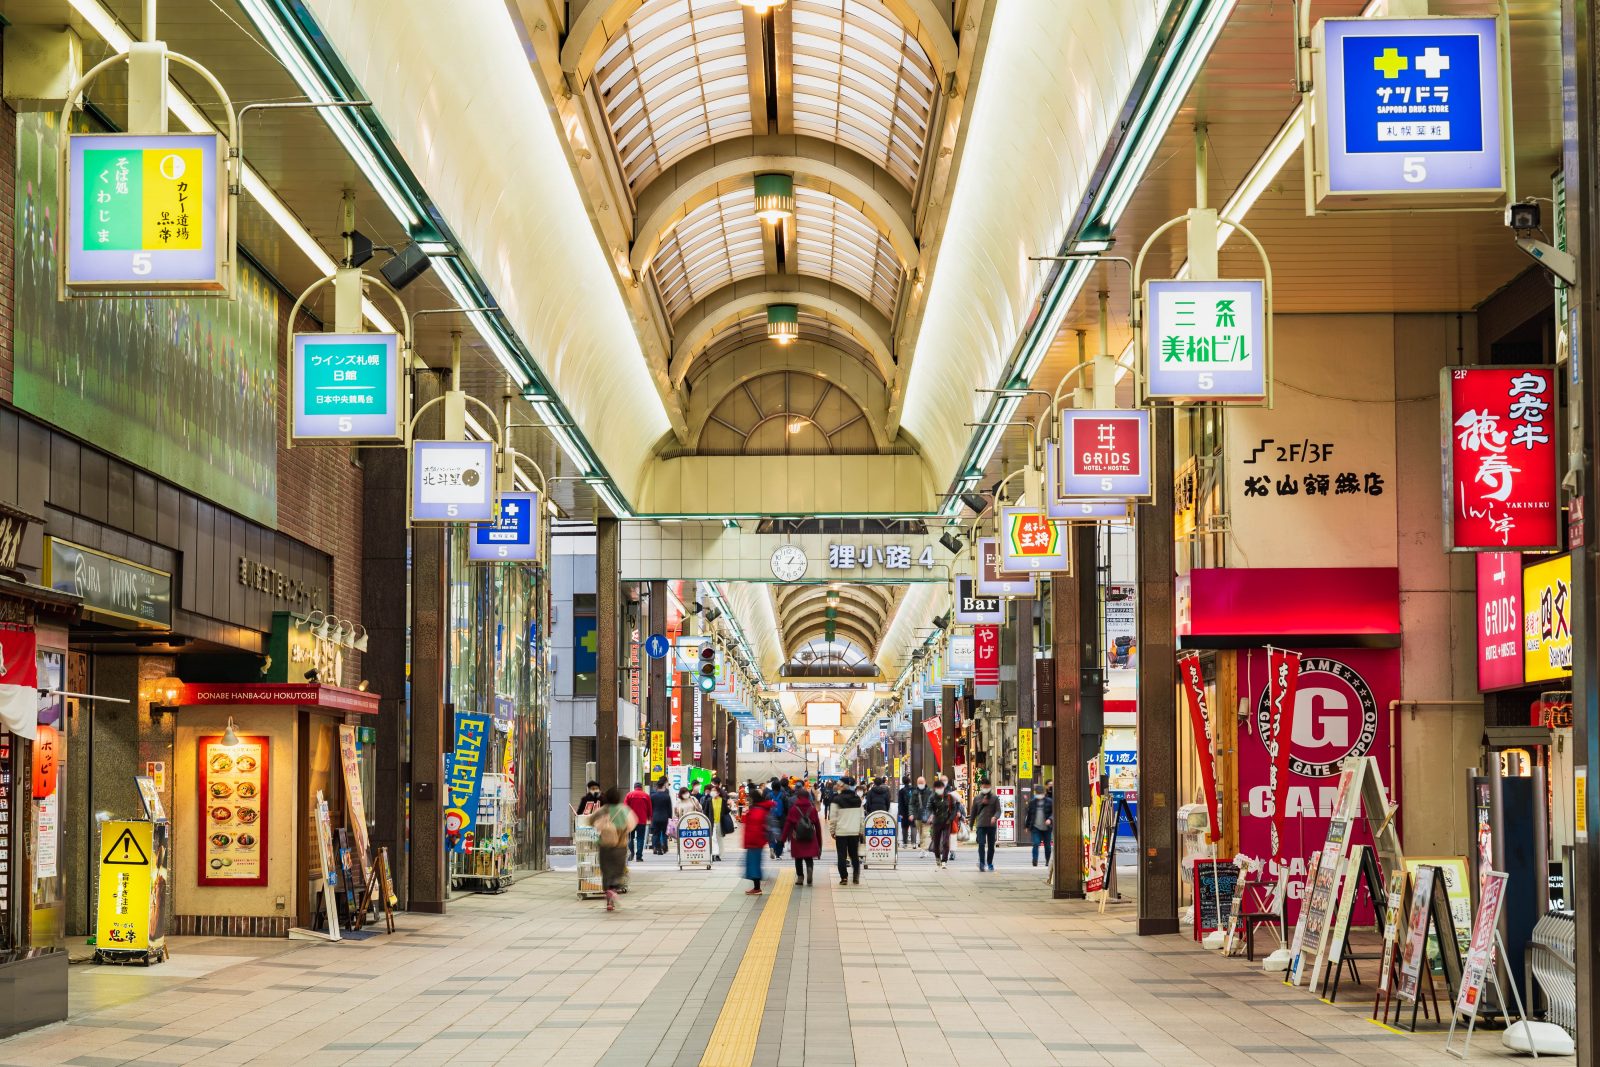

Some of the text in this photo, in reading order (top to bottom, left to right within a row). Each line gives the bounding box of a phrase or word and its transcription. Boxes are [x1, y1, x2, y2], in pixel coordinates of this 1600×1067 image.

[1376, 87, 1450, 104] サツドラ
[1377, 105, 1449, 115] SAPPORO DRUG STORE
[115, 157, 129, 195] そば処
[1403, 156, 1427, 183] 5
[97, 169, 112, 243] くわじま
[176, 181, 190, 241] カレー道場
[132, 252, 152, 275] 5
[1162, 335, 1250, 363] 美松ビル
[311, 354, 380, 366] ウインズ札幌
[1198, 372, 1214, 390] 5
[1454, 369, 1468, 380] 2F
[316, 395, 374, 404] 日本中央競馬会
[1508, 371, 1550, 451] 白老牛
[339, 416, 352, 432] 5
[1082, 452, 1132, 465] GRIDS
[1276, 438, 1335, 463] 2F/3F
[1083, 464, 1131, 472] HOTEL HOSTEL
[1101, 478, 1113, 491] 5
[446, 504, 458, 517] 5
[1505, 502, 1551, 510] YAKINIKU
[1020, 531, 1050, 548] 王将
[498, 545, 508, 557] 5
[829, 544, 936, 570] 狸小路 4
[1031, 558, 1040, 568] 5
[111, 566, 138, 611] WINS
[963, 597, 997, 611] Bar
[1484, 596, 1517, 637] GRIDS
[197, 690, 229, 700] DONABE
[230, 690, 272, 700] HANBA-GU
[273, 690, 317, 700] HOKUTOSEI
[42, 742, 53, 788] ホッピー
[450, 718, 486, 795] EZOCA
[1293, 761, 1331, 781] GATE
